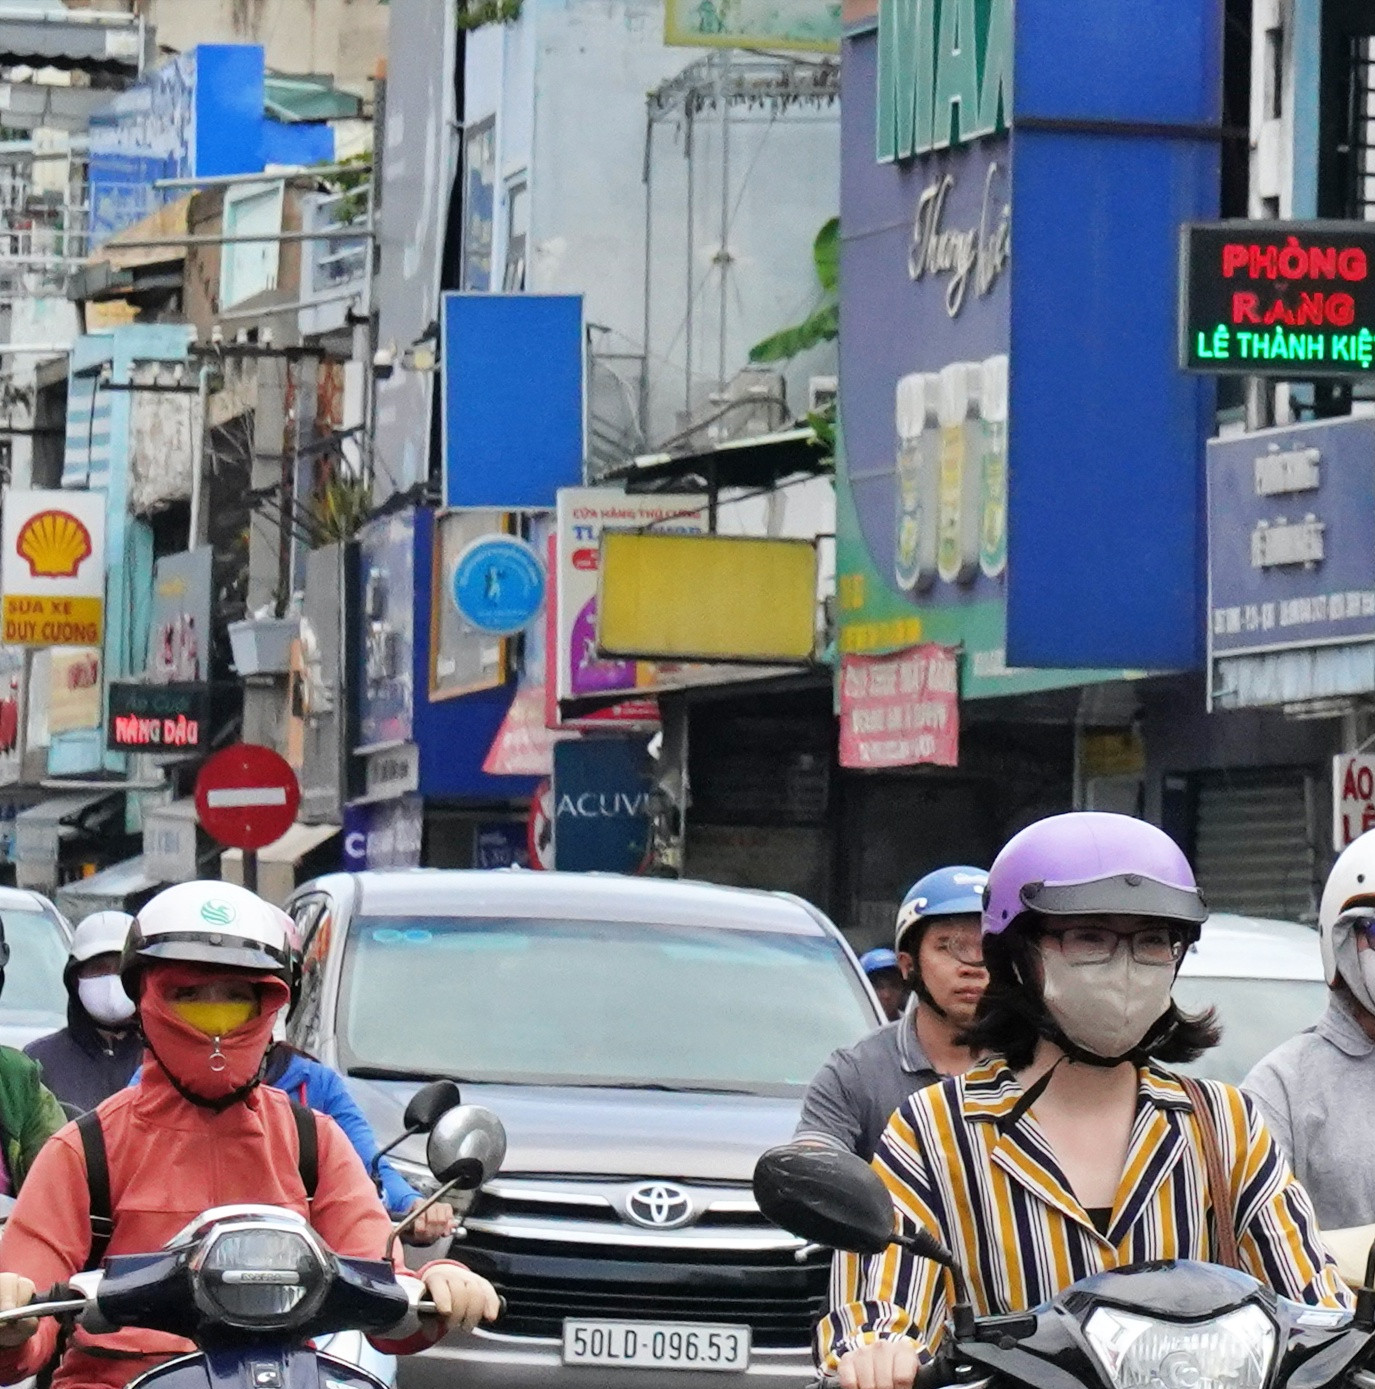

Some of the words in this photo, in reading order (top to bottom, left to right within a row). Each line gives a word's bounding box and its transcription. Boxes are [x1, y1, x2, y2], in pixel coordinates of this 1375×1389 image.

[1221, 236, 1368, 282] PHÒNG
[1198, 323, 1229, 359] LÊ
[1237, 325, 1324, 361] THÀNH
[1342, 758, 1373, 801] ÁO
[574, 1327, 739, 1363] 50LD-096.53
